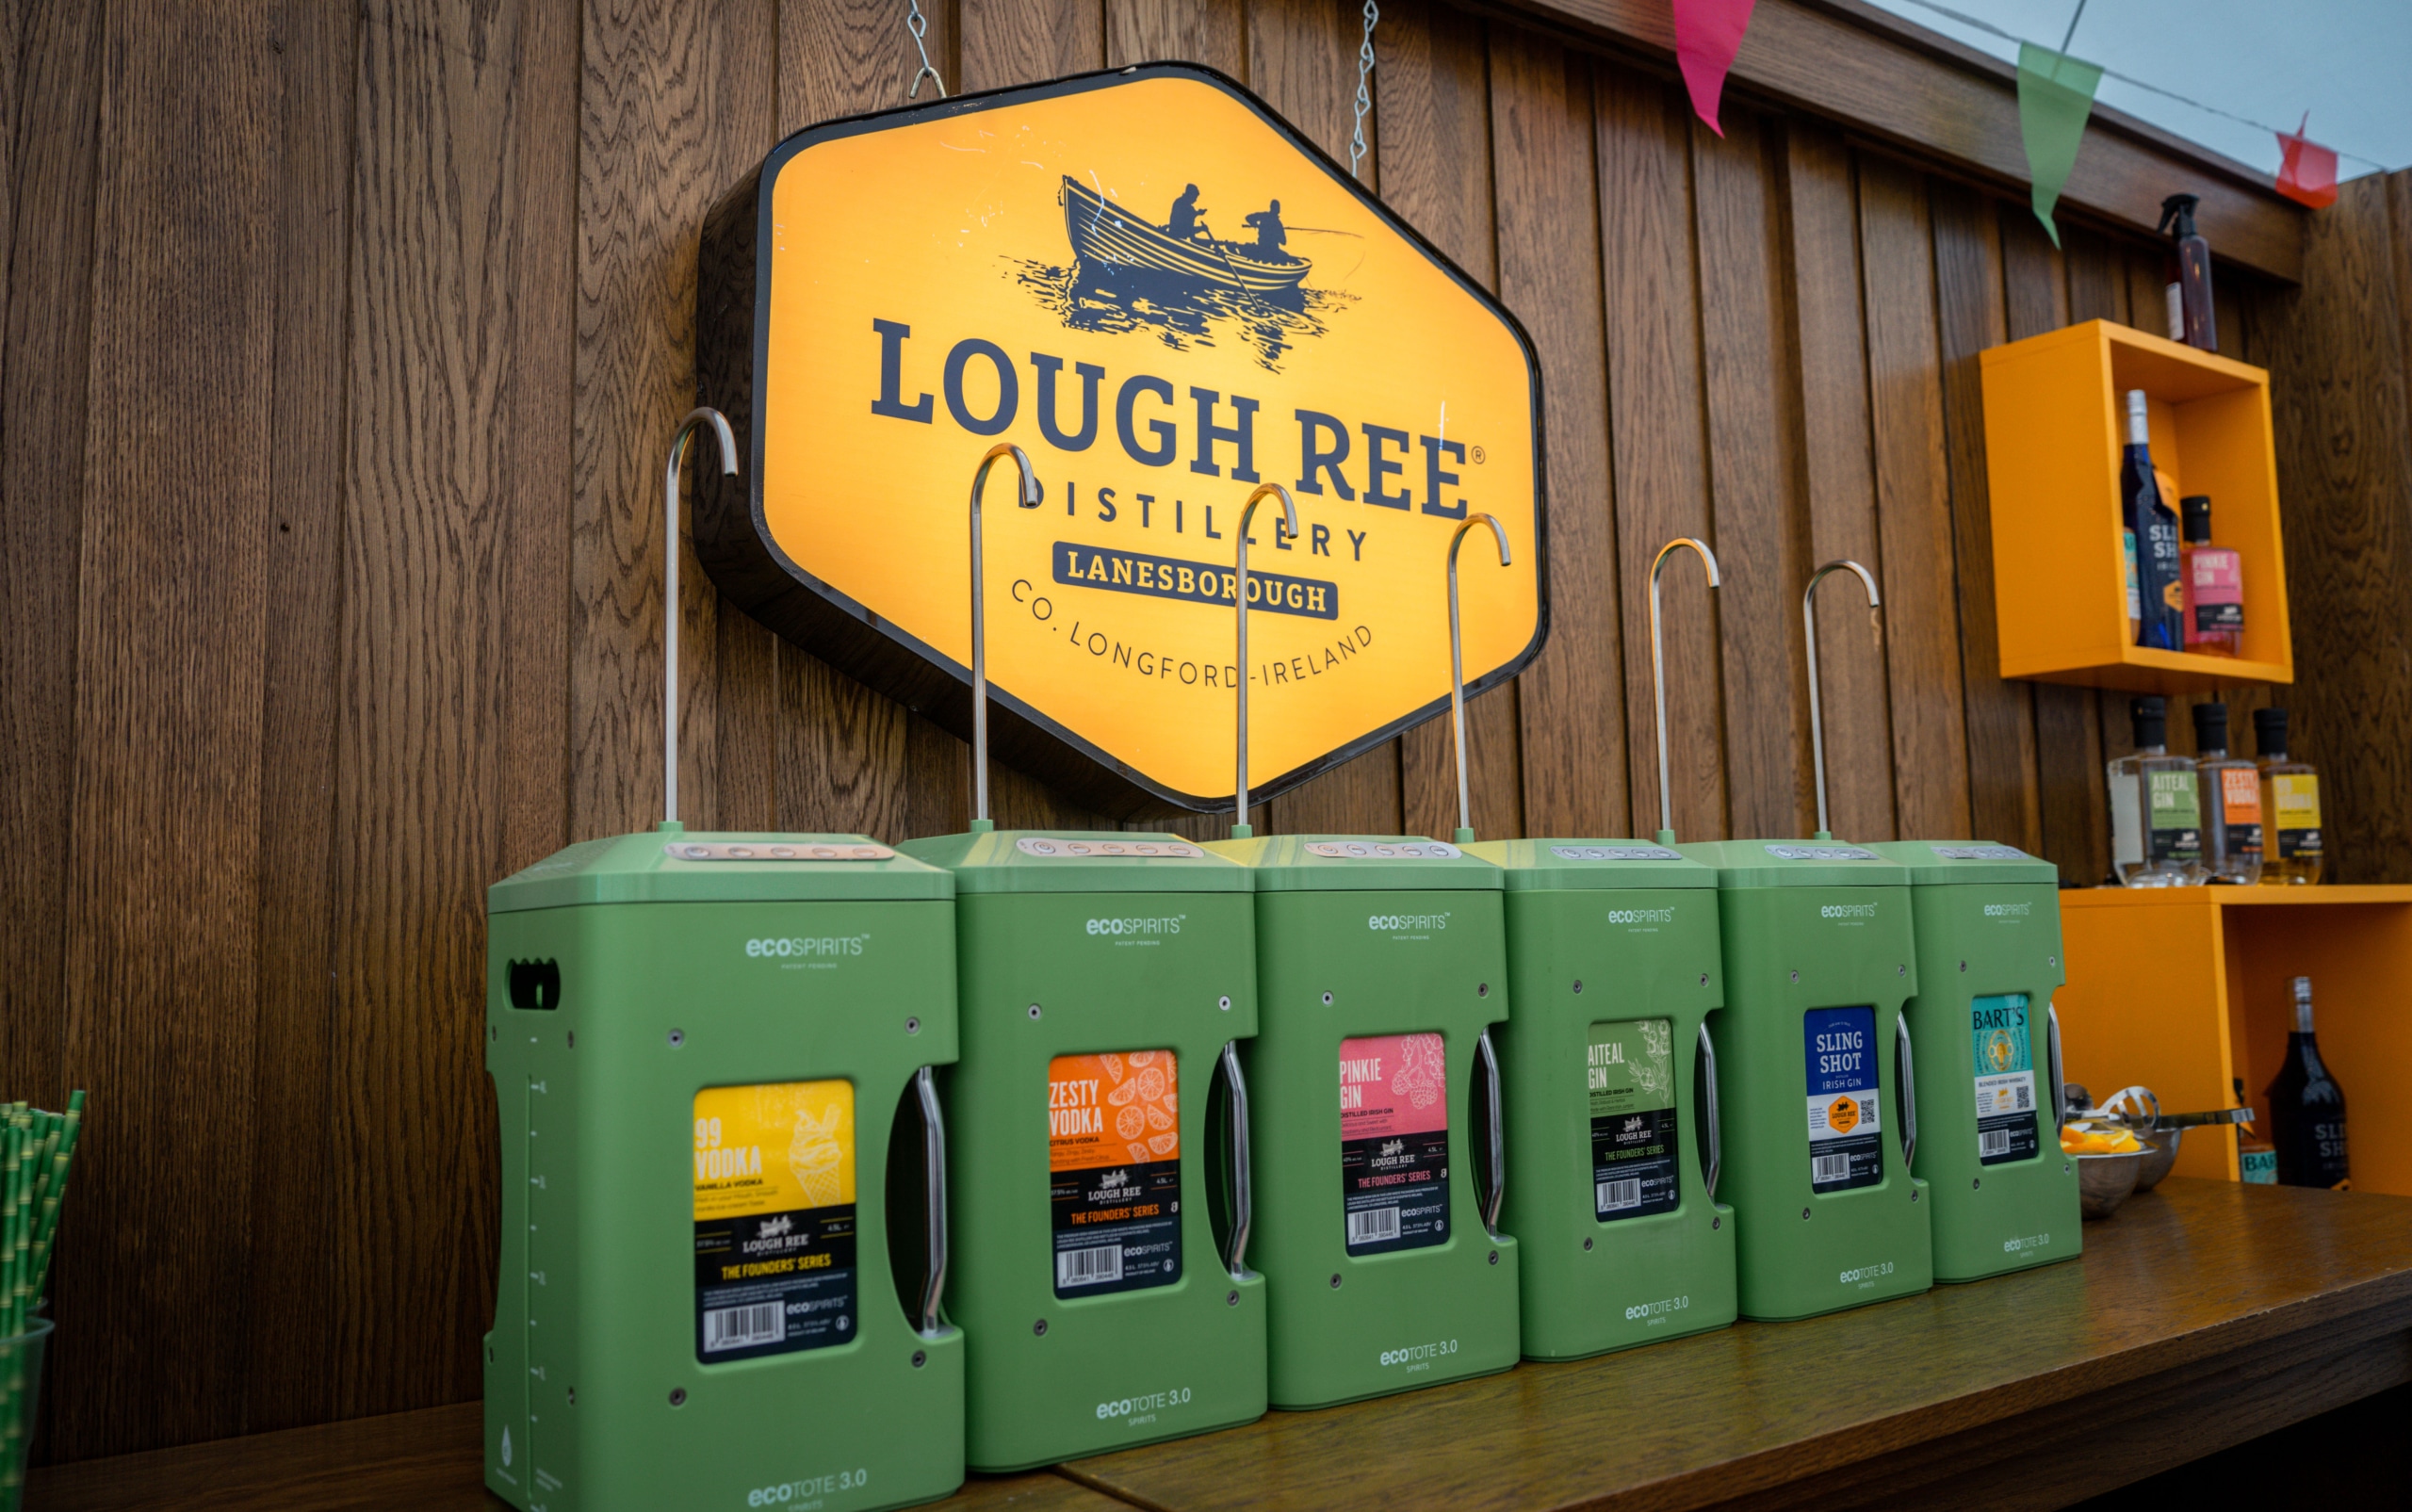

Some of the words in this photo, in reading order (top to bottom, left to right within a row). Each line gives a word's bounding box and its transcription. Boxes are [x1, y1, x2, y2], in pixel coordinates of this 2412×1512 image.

[872, 318, 1260, 483] LOUGH
[1019, 472, 1367, 561] DISTILERY
[1067, 551, 1327, 611] LANESBOROUGH
[1012, 579, 1057, 632] CO.
[2152, 791, 2175, 808] GIN
[1973, 1006, 2025, 1030] BART'S
[1817, 1031, 1863, 1052] SLING
[1588, 1042, 1624, 1066] AITEAL
[1819, 1052, 1862, 1074] SHOT
[1340, 1058, 1382, 1084] PINKIE
[1589, 1066, 1607, 1089] GIN
[1049, 1080, 1099, 1108] ZESTY
[1822, 1079, 1845, 1090] IRISH
[1847, 1078, 1862, 1087] GIN
[1340, 1084, 1362, 1110] GIN
[695, 1117, 722, 1148] 99
[1049, 1107, 1103, 1136] VODKA
[1050, 1138, 1073, 1146] CITRUS
[1616, 1131, 1638, 1142] LOUGH
[1639, 1130, 1652, 1139] REE
[694, 1146, 762, 1180] VODKA
[1371, 1156, 1397, 1167] LOUGH
[1399, 1154, 1415, 1163] REE
[1605, 1151, 1616, 1161] THE
[1647, 1145, 1665, 1156] SERIES
[734, 1179, 764, 1188] VODKA
[1358, 1178, 1371, 1189] THE
[1408, 1170, 1431, 1183] SERIES
[1088, 1189, 1120, 1201] LOUGH
[1123, 1186, 1142, 1197] REE
[1071, 1212, 1086, 1225] THE
[1133, 1204, 1160, 1217] SERIES
[742, 1237, 783, 1253] LOUGH
[785, 1234, 809, 1247] REE
[722, 1266, 742, 1280] THE
[798, 1253, 832, 1271] SERIES
[1840, 1264, 1880, 1283] ecoTOTE
[1881, 1261, 1894, 1275] 3.0
[1625, 1299, 1672, 1320] ecoTOTE
[1673, 1295, 1688, 1310] 3.0
[1380, 1343, 1437, 1366] ecoTOTE
[1440, 1339, 1458, 1355] 3.0
[1406, 1362, 1429, 1373] SPIRITS
[1096, 1392, 1165, 1420] ecoTOTE
[1168, 1387, 1191, 1406] 3.0
[1128, 1414, 1156, 1426] SPIRITS
[747, 1475, 836, 1507] ecoTOTE
[839, 1468, 867, 1490] 3.0
